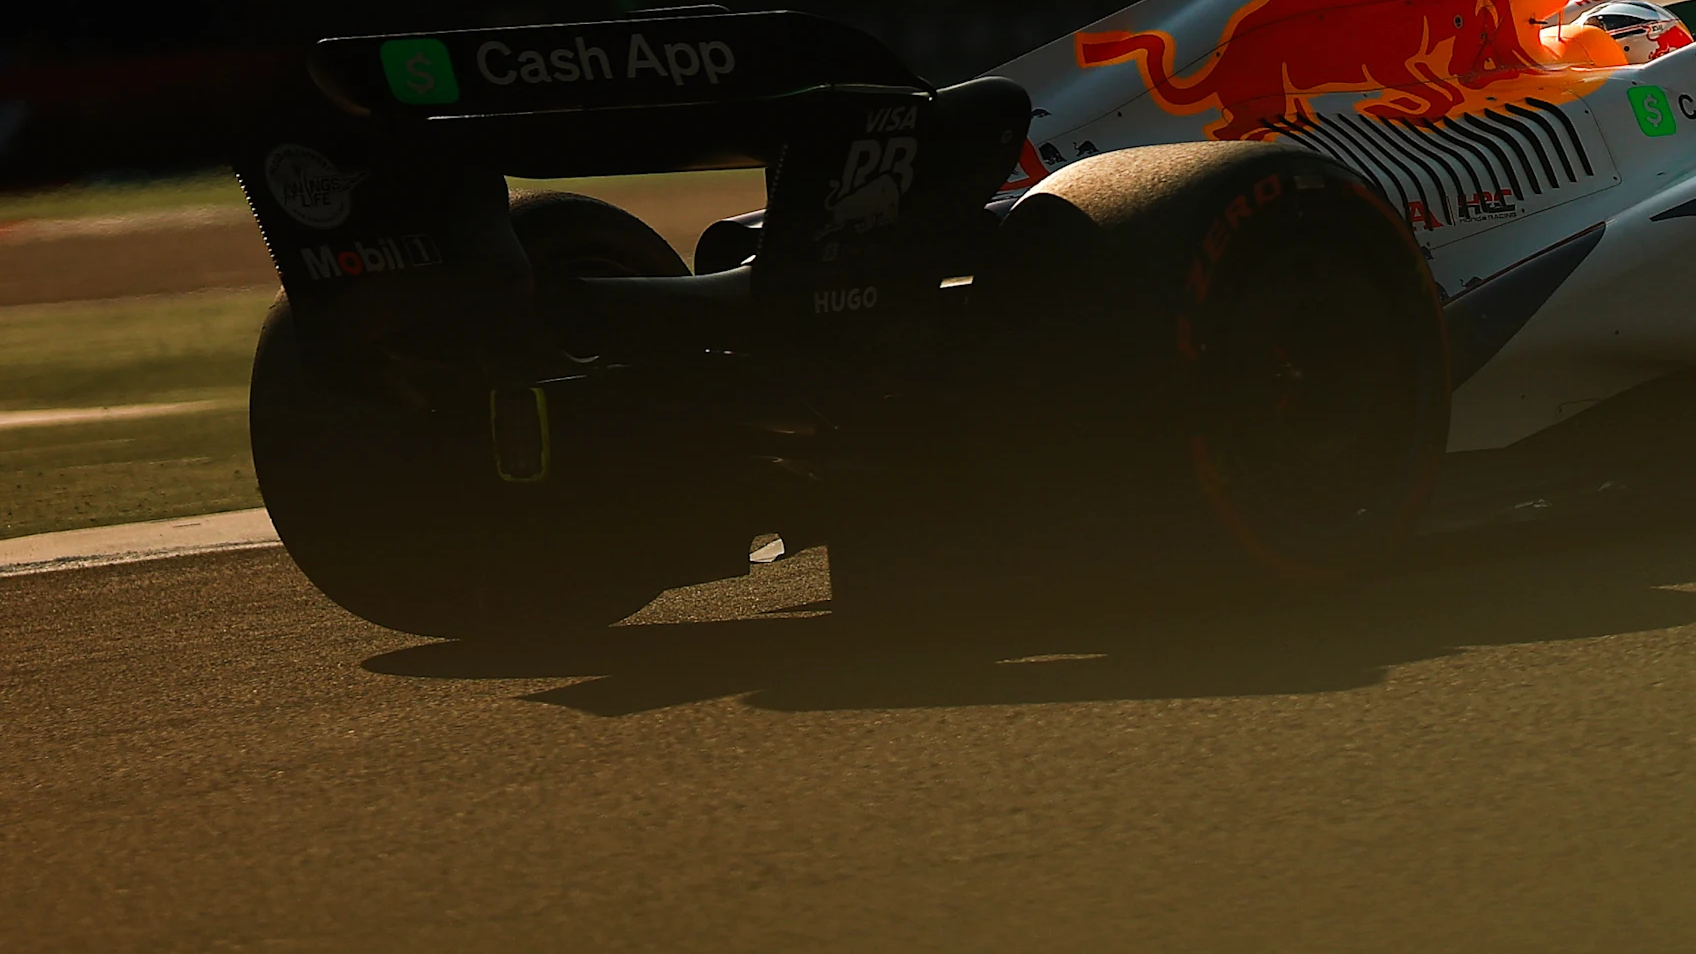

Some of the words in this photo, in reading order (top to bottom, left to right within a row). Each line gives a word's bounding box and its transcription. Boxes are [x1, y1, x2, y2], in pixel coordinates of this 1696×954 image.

[476, 39, 614, 86] Cash
[626, 32, 736, 87] App
[865, 106, 918, 134] VISA
[301, 237, 405, 281] Mobil
[812, 285, 878, 315] HUGO
